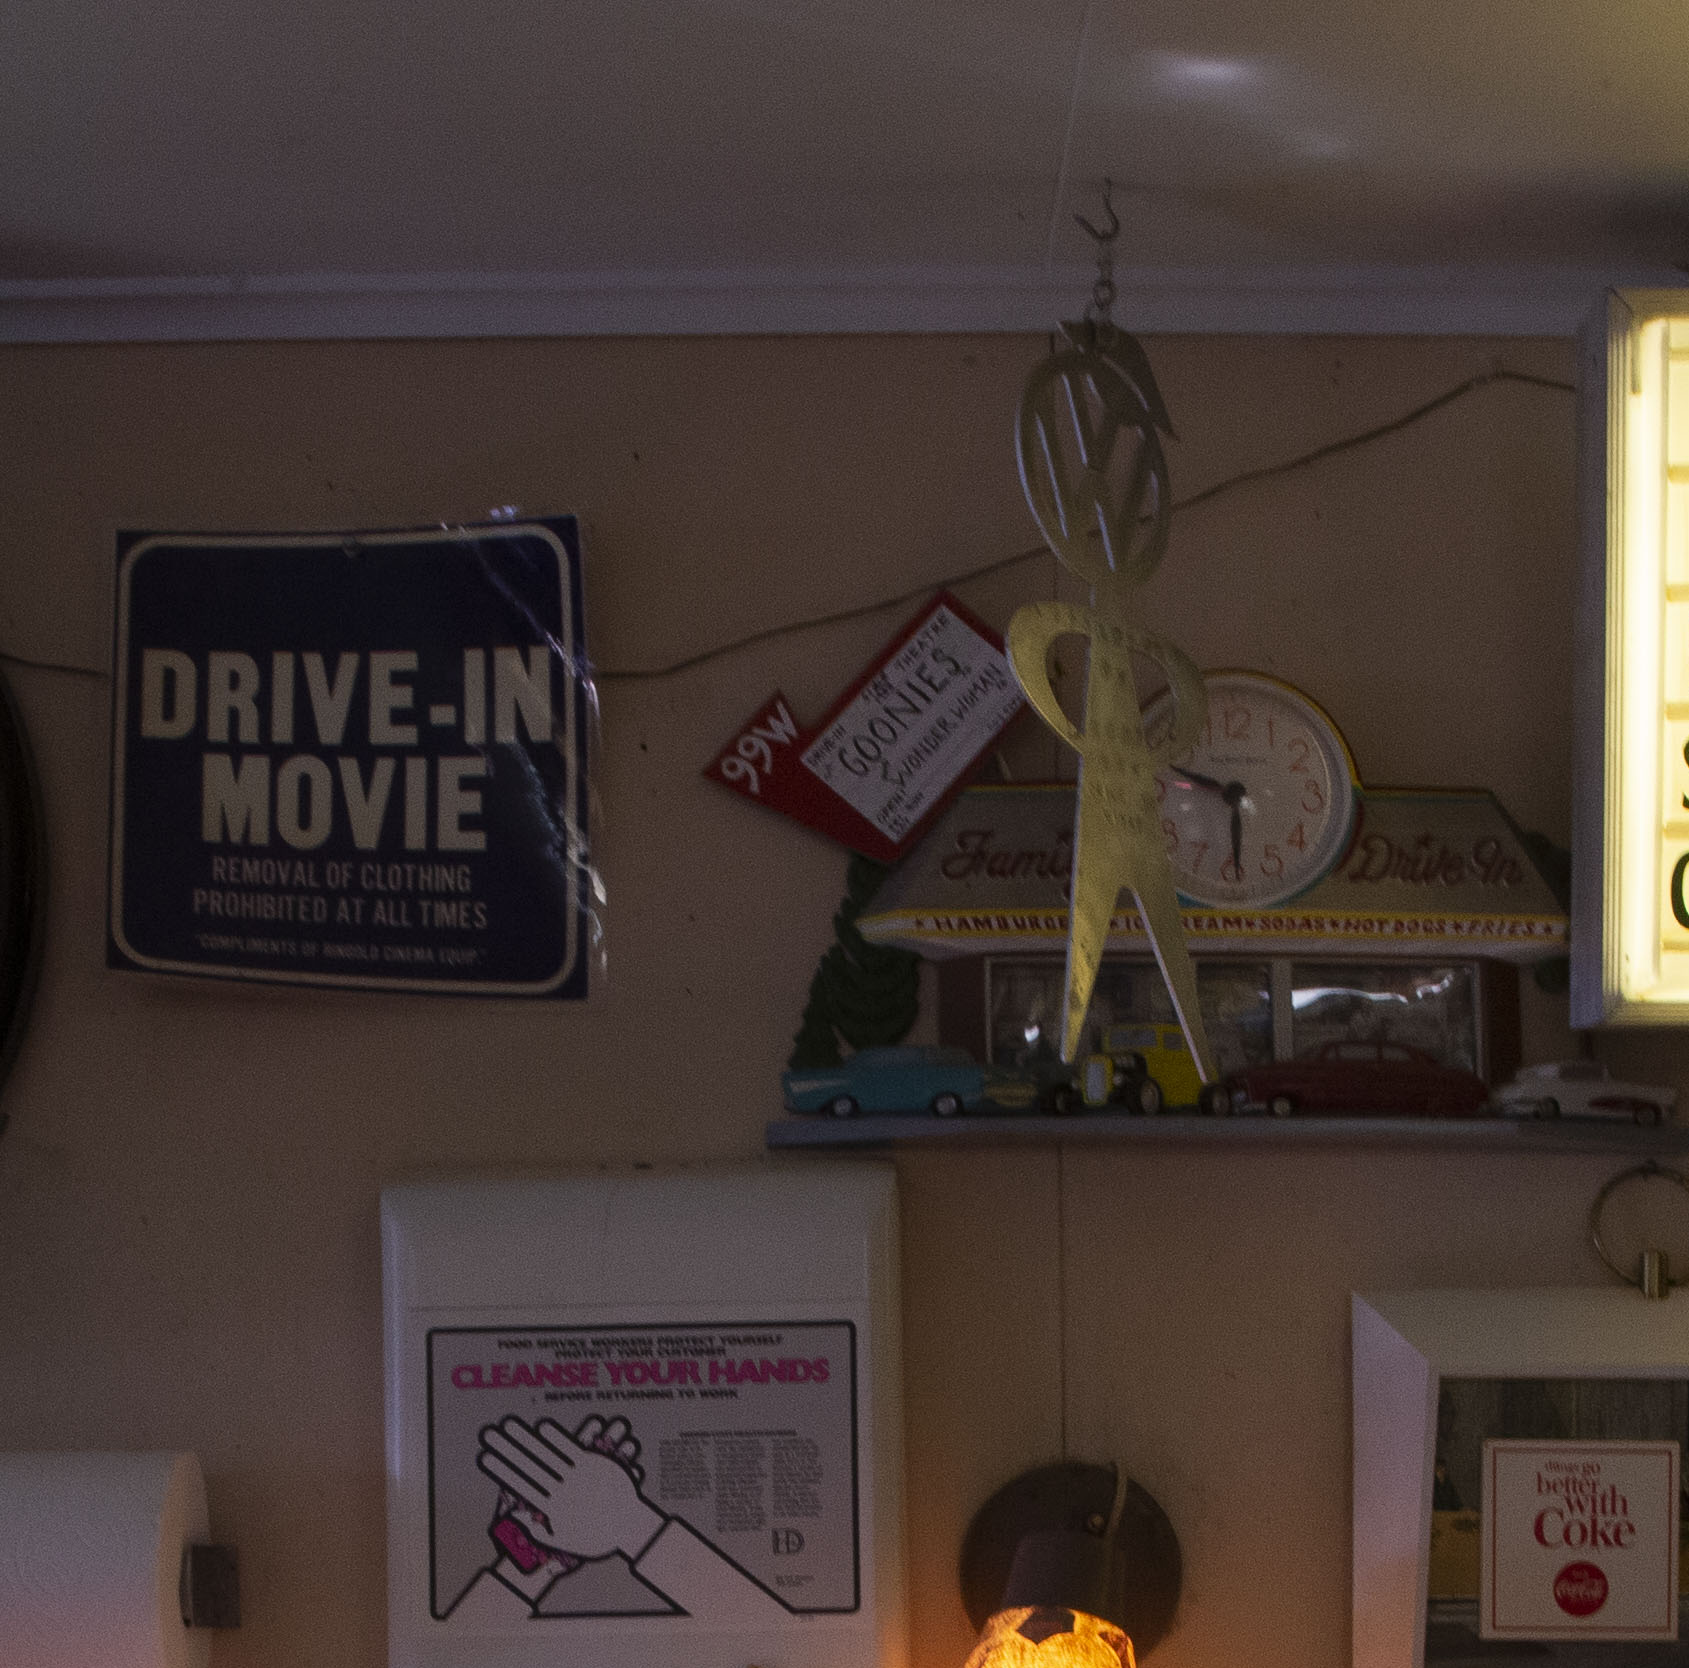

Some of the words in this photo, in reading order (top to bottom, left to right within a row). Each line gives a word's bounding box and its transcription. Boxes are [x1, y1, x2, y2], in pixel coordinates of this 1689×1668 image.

[139, 644, 552, 746] DRIVE-IN
[837, 648, 962, 777] GOONIES
[722, 700, 798, 794] 99W
[201, 752, 488, 852] MOVIE
[212, 856, 321, 888] REMOVAL
[325, 861, 354, 889] OF
[361, 863, 472, 893] CLOTHING
[192, 888, 327, 923] PROHIBITED
[336, 897, 365, 925] AT
[372, 899, 412, 927] ALL
[419, 902, 489, 929] TIMES
[451, 1361, 599, 1390] CLEANSE
[605, 1359, 702, 1387] YOUR
[709, 1357, 830, 1385] HANDS
[1537, 1471, 1599, 1495] better
[1562, 1484, 1629, 1517] with
[1533, 1506, 1637, 1550] Coke
